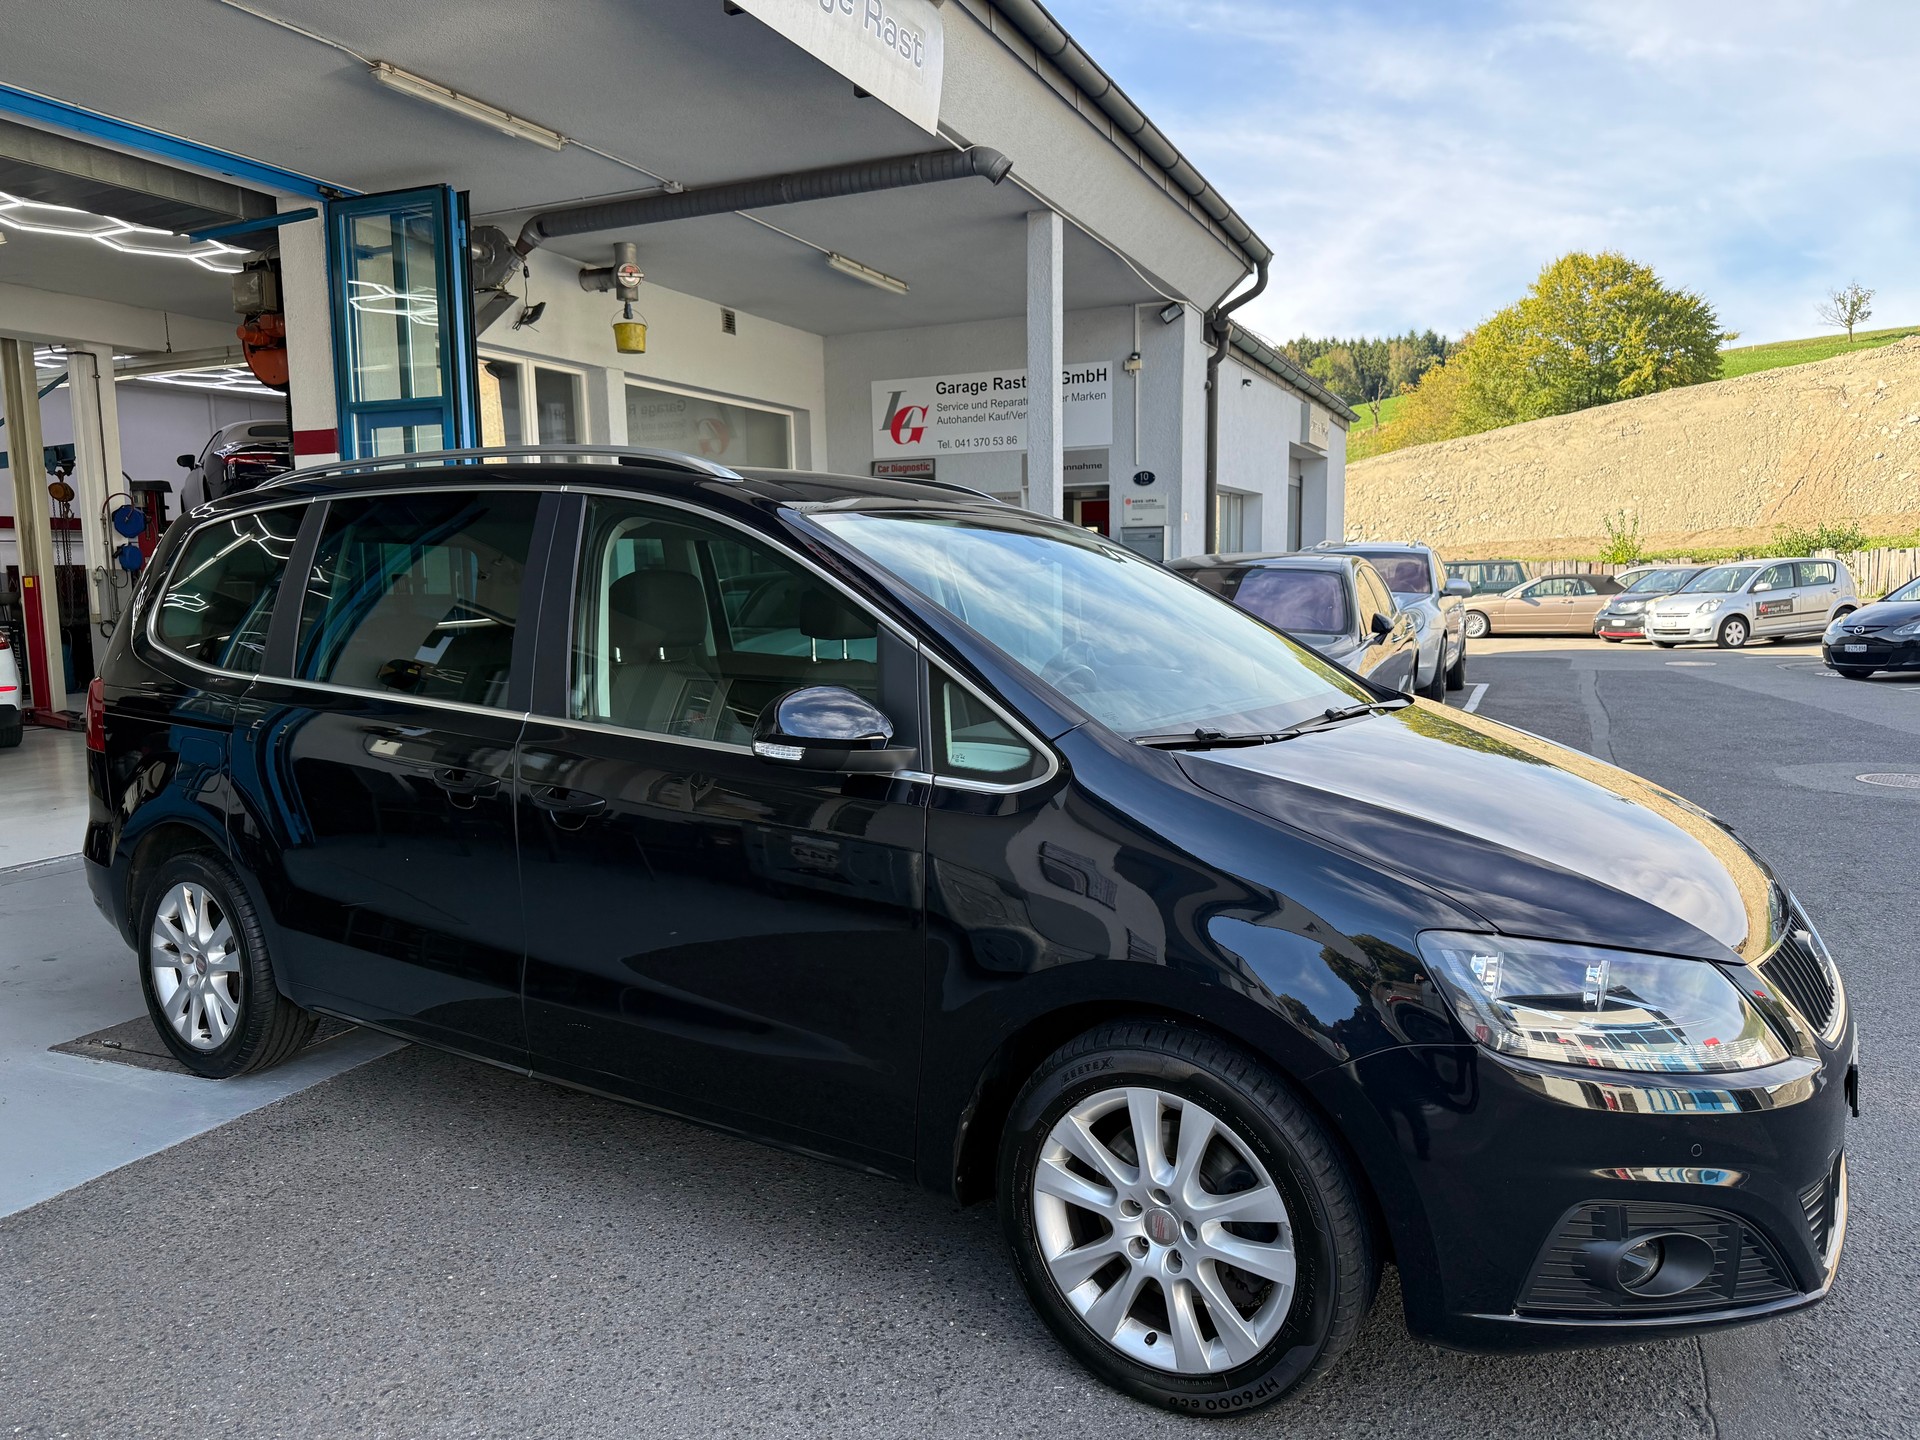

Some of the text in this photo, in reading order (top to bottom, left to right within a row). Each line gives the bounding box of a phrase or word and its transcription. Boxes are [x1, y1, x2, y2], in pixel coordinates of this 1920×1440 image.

[863, 0, 923, 68] Rast
[936, 368, 1107, 396] Garage Rast GmbH
[936, 402, 969, 413] Service
[971, 400, 988, 410] und
[1062, 394, 1069, 402] r
[1071, 391, 1107, 402] Marken
[936, 410, 1028, 425] Autohandel Kauf/Ver
[938, 435, 1018, 449] Tel. 041 370 53 86
[877, 462, 931, 474] Car Diagnostic
[1139, 472, 1149, 480] 10
[1061, 1056, 1114, 1083] ZEETEX
[1168, 1396, 1200, 1408] eco
[1205, 1376, 1279, 1411] HP6000
